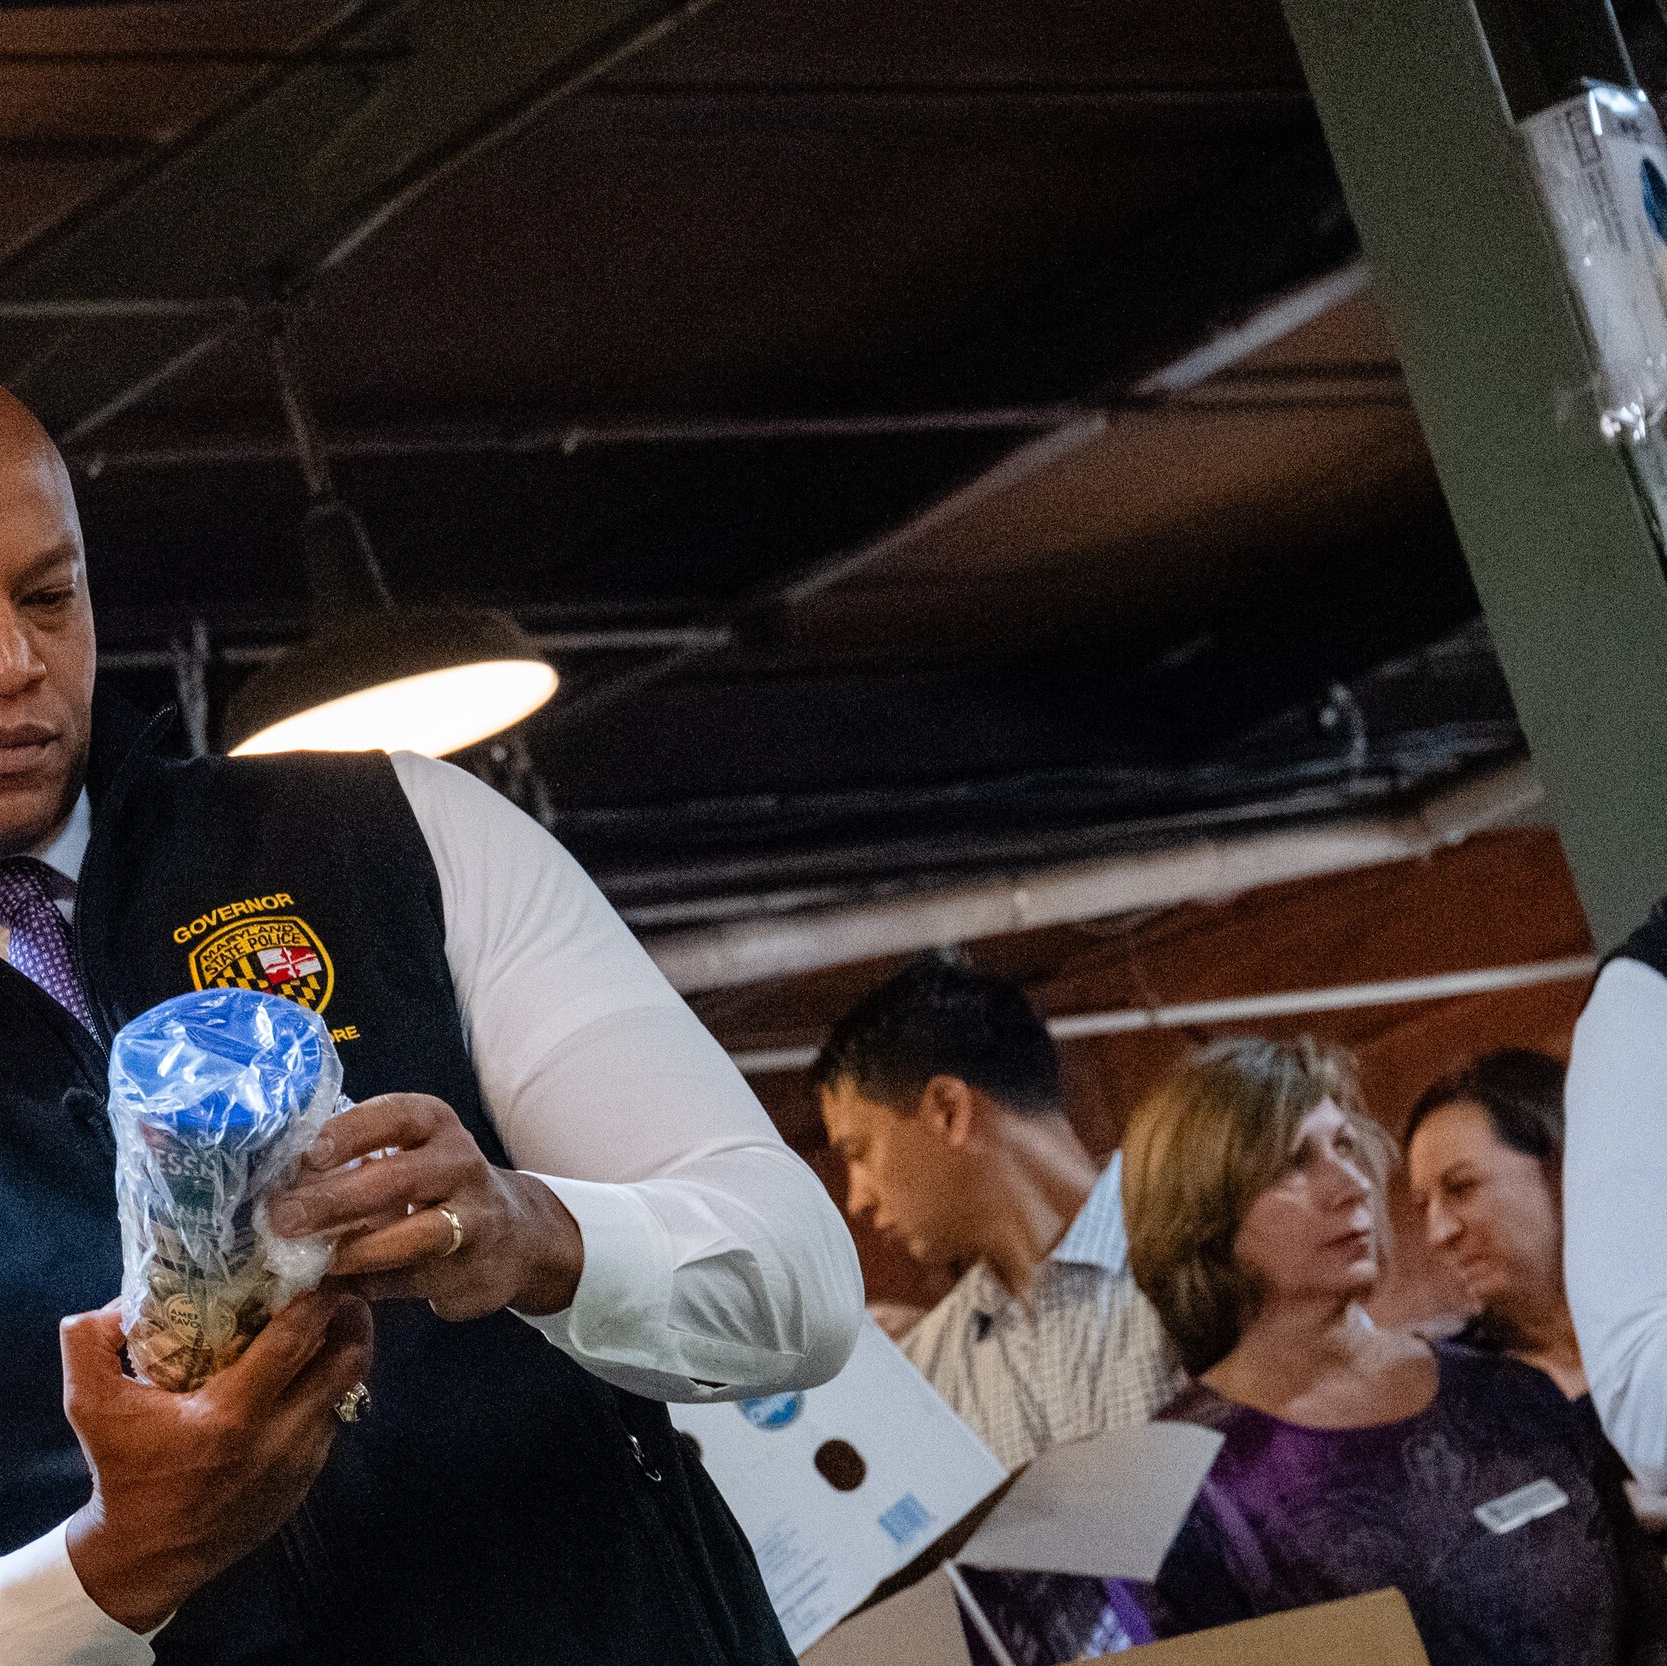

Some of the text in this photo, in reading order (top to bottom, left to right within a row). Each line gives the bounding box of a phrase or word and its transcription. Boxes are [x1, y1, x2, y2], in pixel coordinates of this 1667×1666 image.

[173, 892, 294, 943] GOVERNOR
[203, 924, 294, 962] MARYLAND
[204, 931, 301, 975] STATE POLICE
